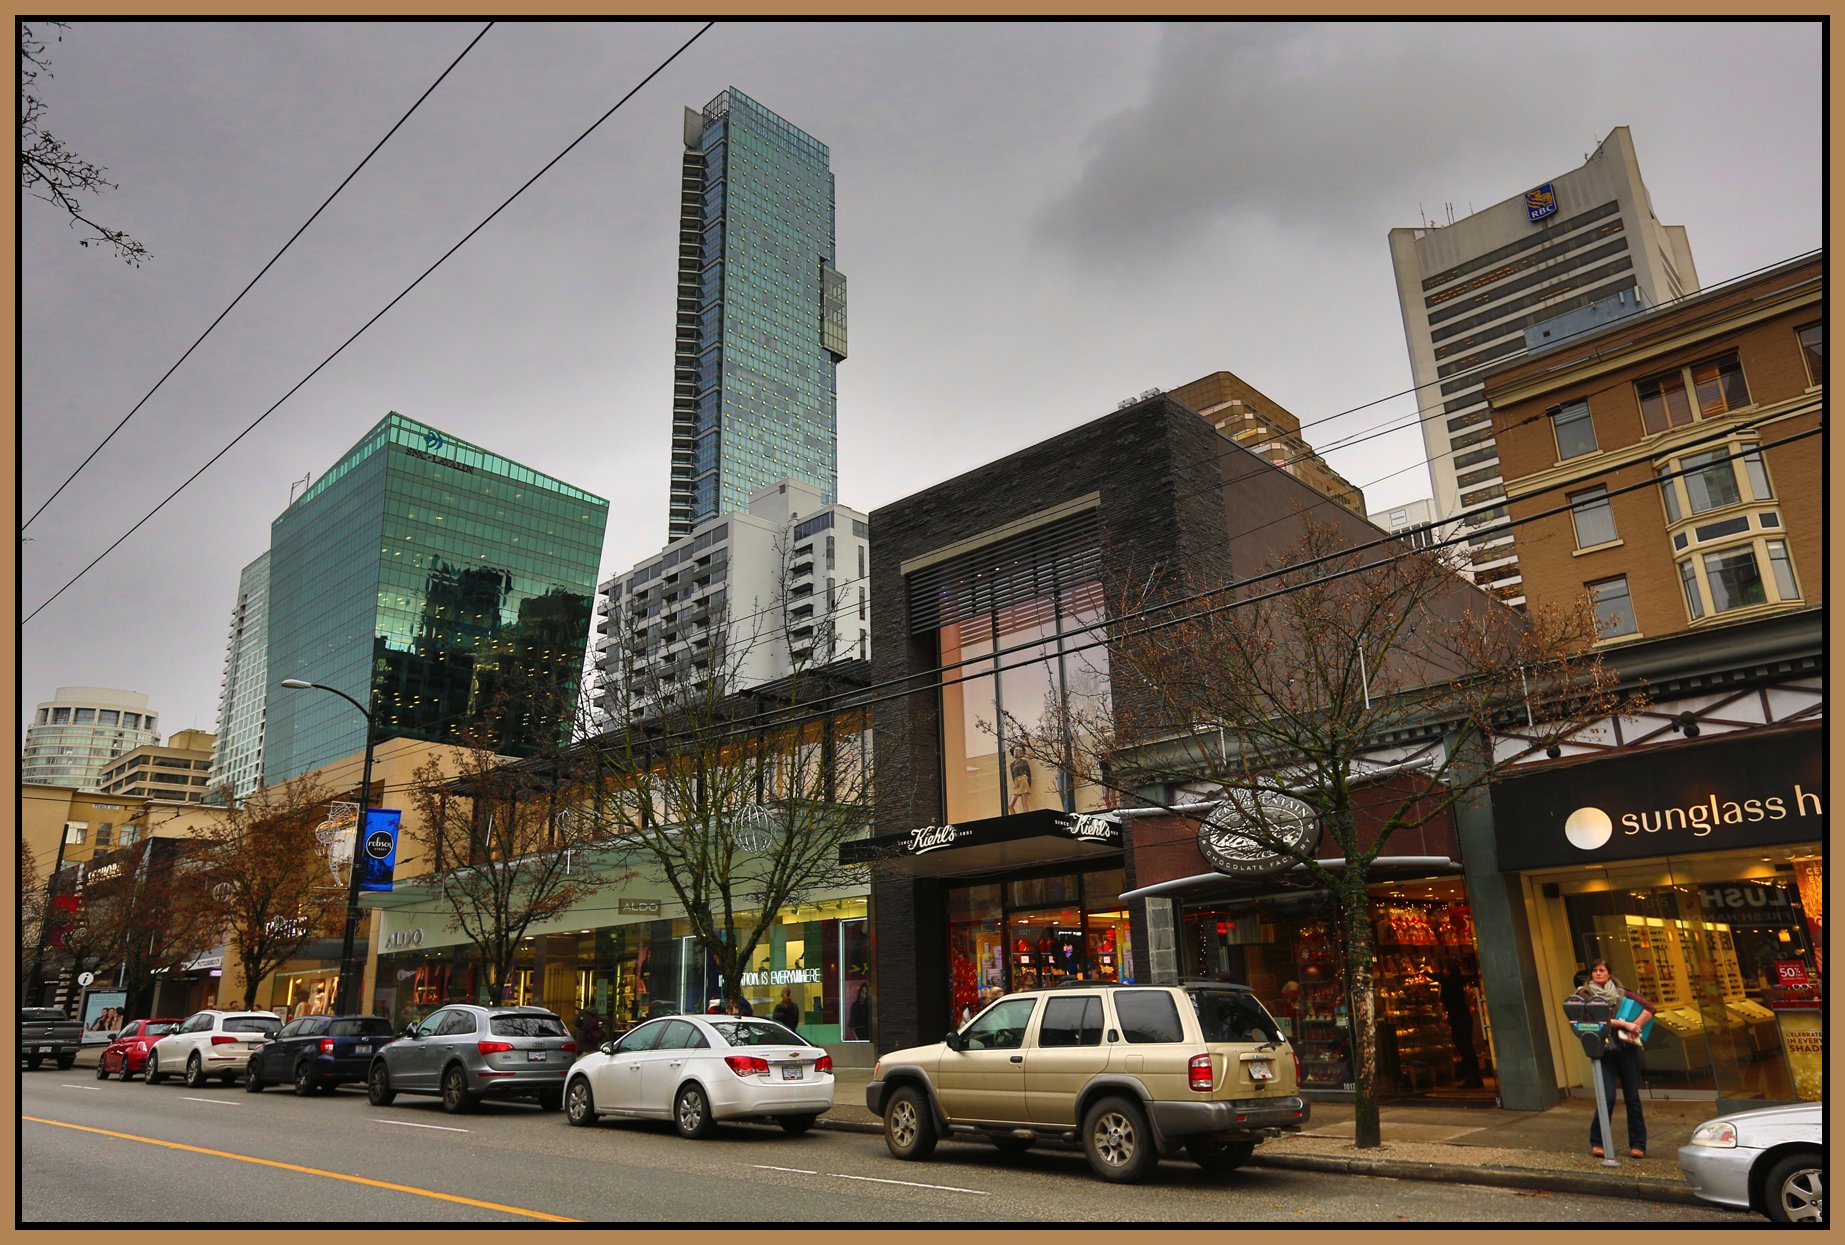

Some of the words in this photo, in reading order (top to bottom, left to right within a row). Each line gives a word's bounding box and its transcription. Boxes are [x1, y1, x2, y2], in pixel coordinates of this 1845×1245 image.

[1531, 204, 1553, 218] RBC
[1069, 812, 1111, 838] Kiehl's
[1621, 794, 1787, 836] sunglass
[368, 836, 393, 849] robson
[907, 824, 957, 851] Kiehl's
[1206, 849, 1264, 871] CHOCOLATE
[623, 902, 658, 912] ALDO
[385, 927, 424, 950] ALDO
